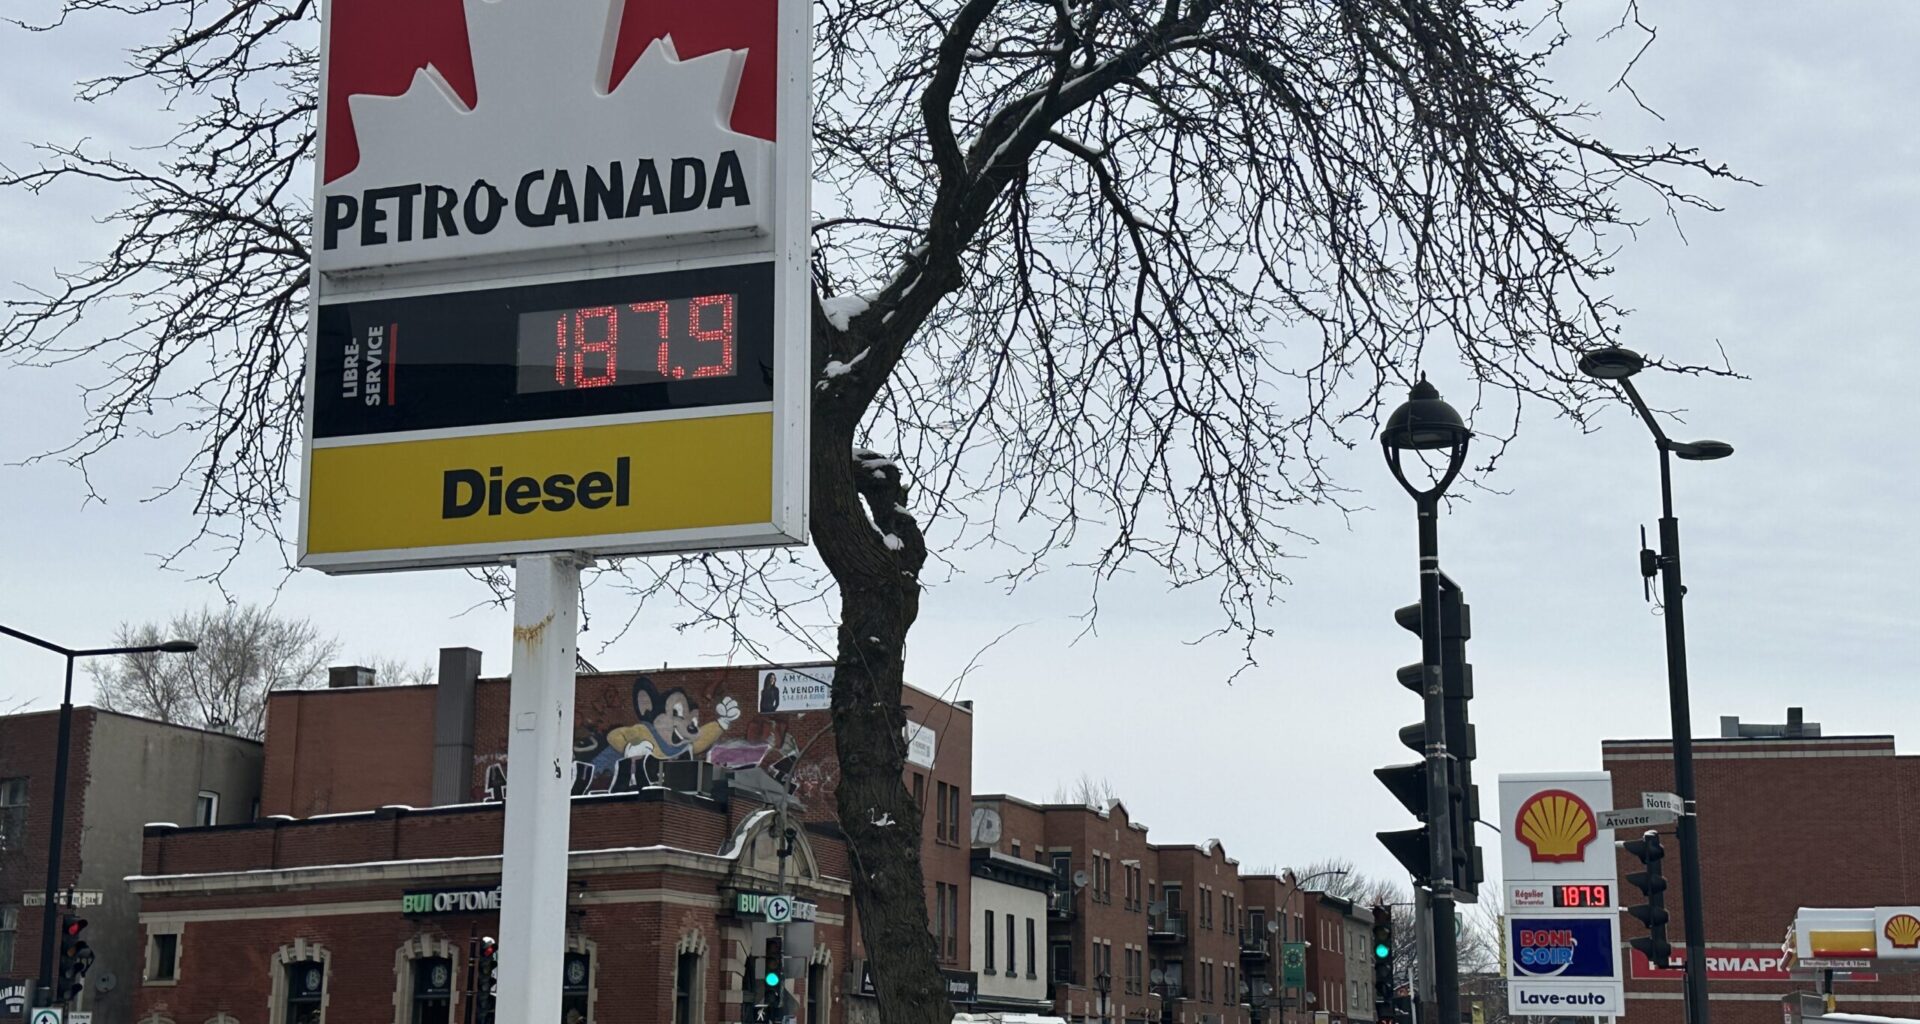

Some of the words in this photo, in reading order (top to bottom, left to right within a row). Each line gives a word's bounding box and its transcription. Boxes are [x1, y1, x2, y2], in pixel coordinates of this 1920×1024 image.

[553, 293, 733, 389] 187.9
[342, 336, 360, 399] LIBRE-
[365, 325, 384, 407] SERVICE
[442, 456, 631, 520] Diesel
[1606, 816, 1649, 827] Atwater
[403, 894, 433, 913] BUI
[1562, 886, 1605, 906] 187.9
[1520, 930, 1572, 947] BONI
[1520, 947, 1573, 965] SOIR
[1520, 990, 1605, 1005] Lave-auto
